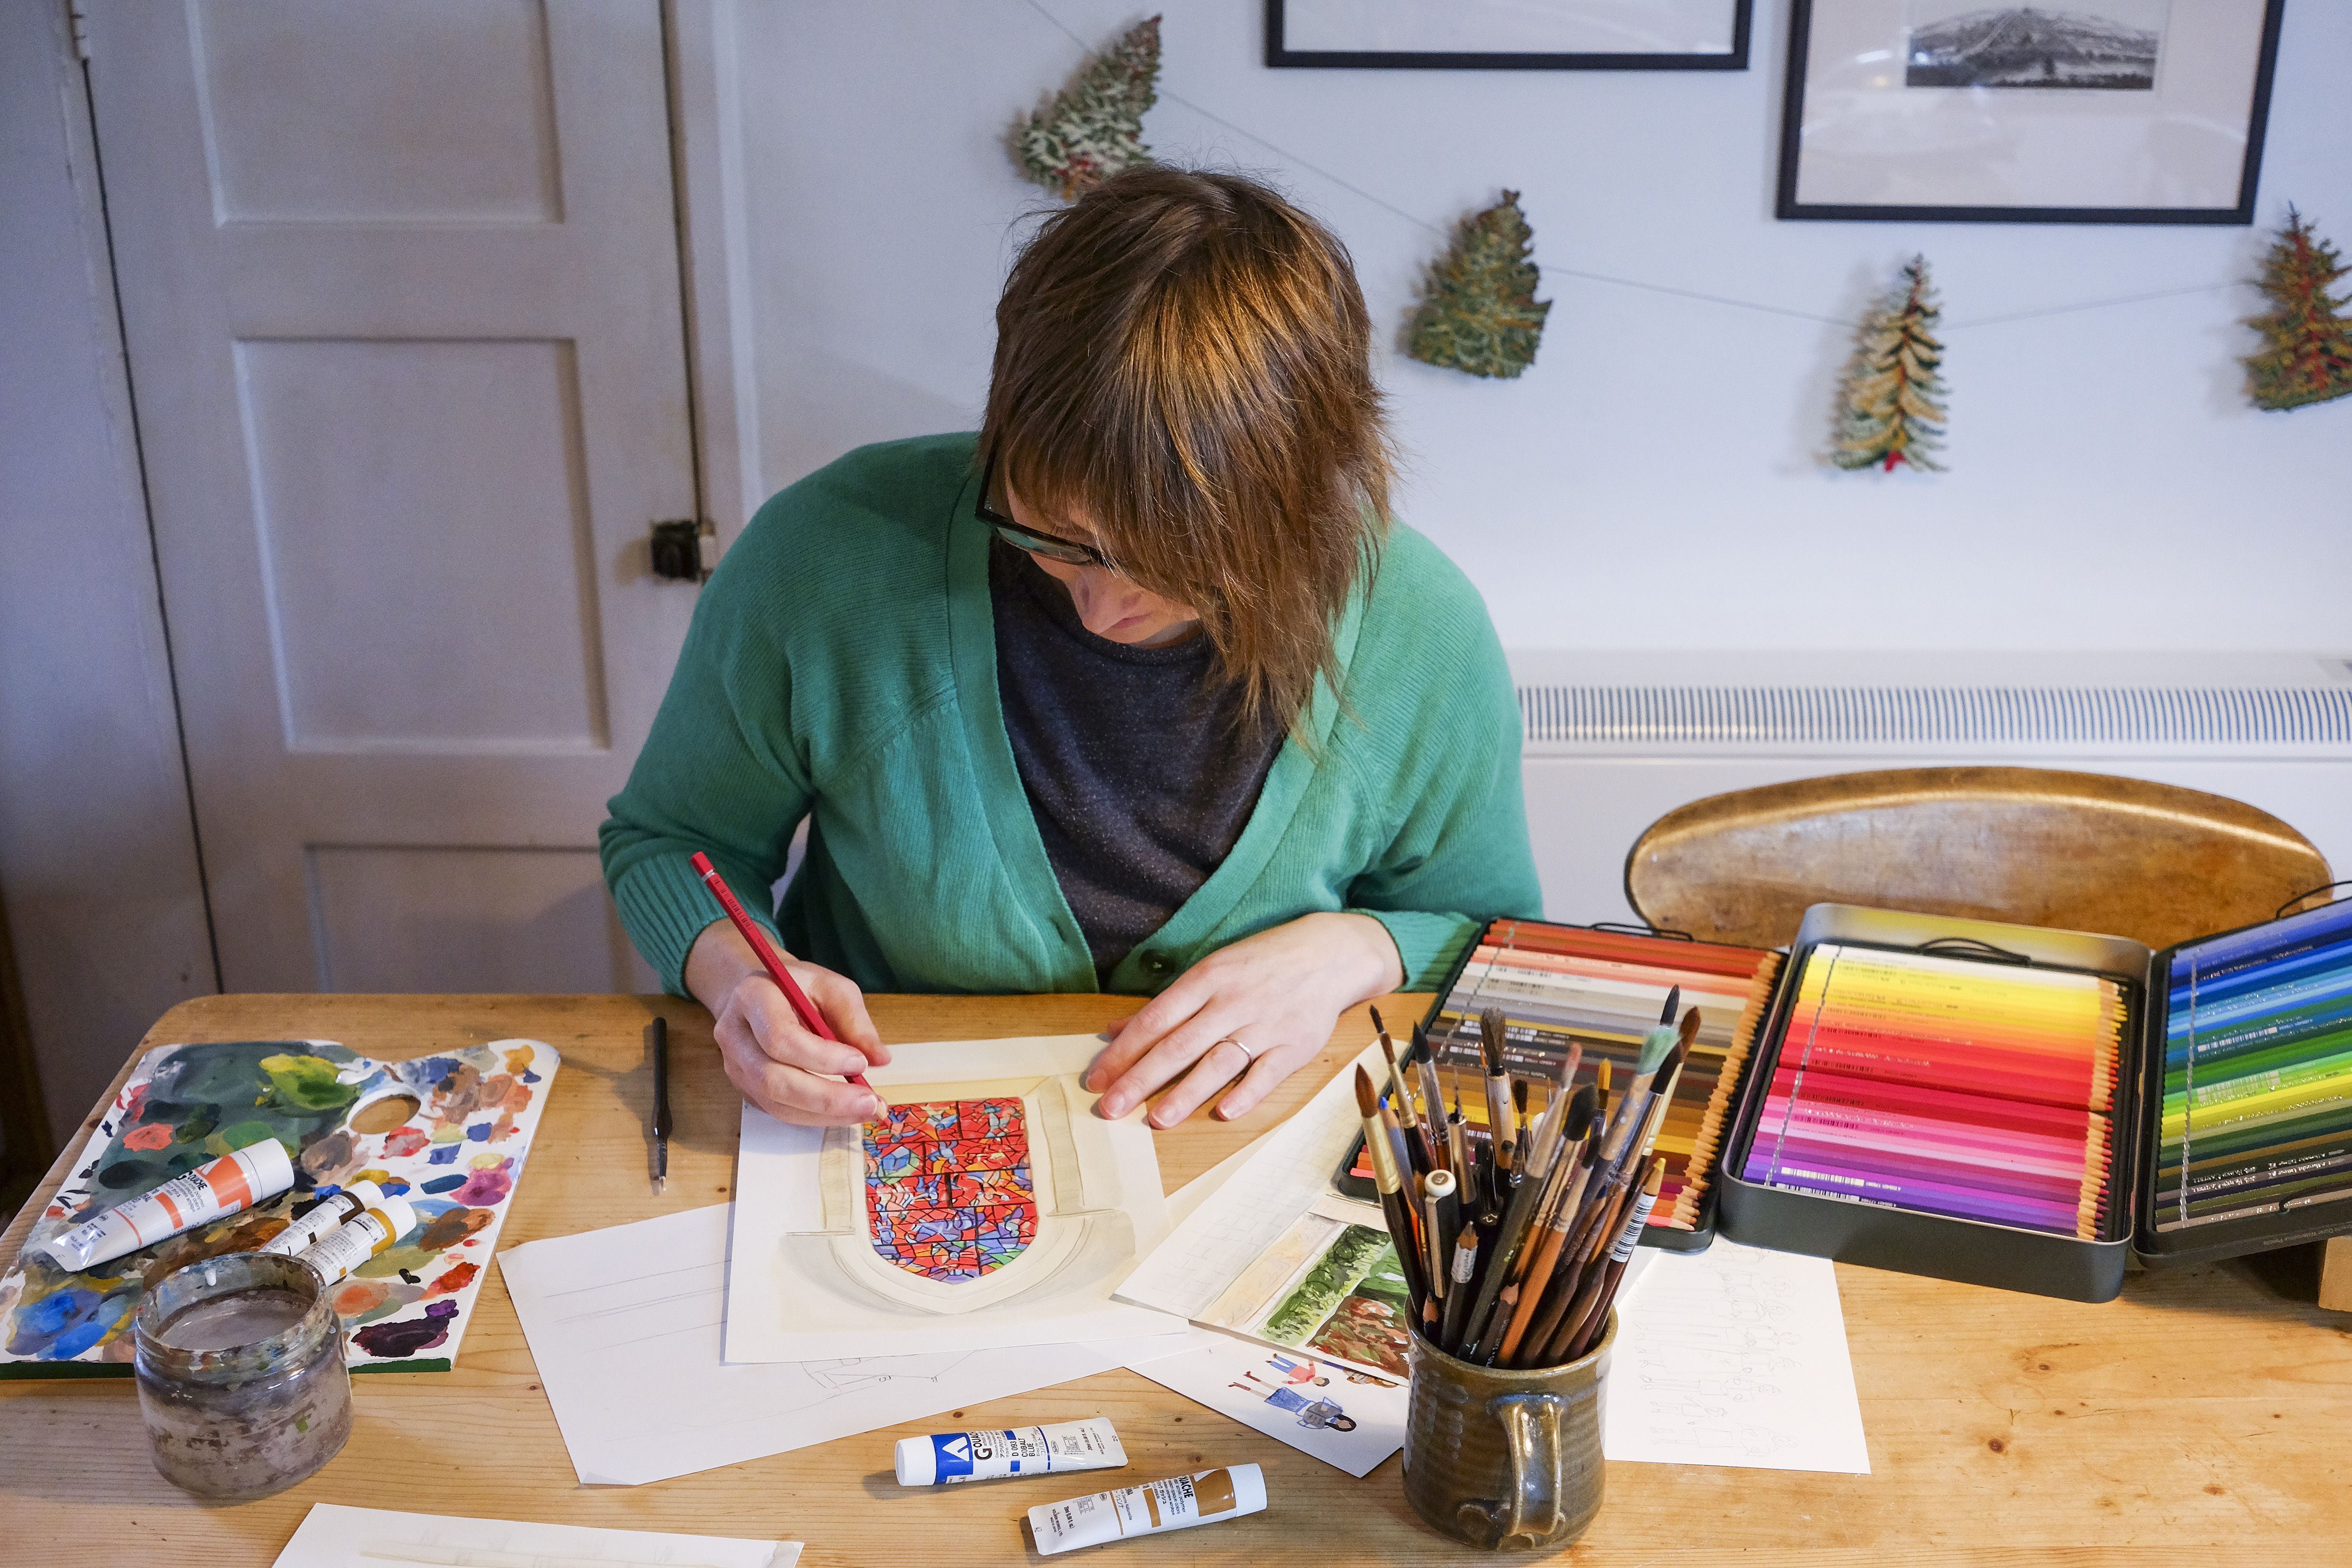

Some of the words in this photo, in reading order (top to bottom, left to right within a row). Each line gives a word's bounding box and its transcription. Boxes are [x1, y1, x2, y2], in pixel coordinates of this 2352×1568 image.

[2284, 1231, 2318, 1242] Watercolour
[970, 1432, 992, 1460] GOUAC
[1018, 1438, 1028, 1457] COBALT
